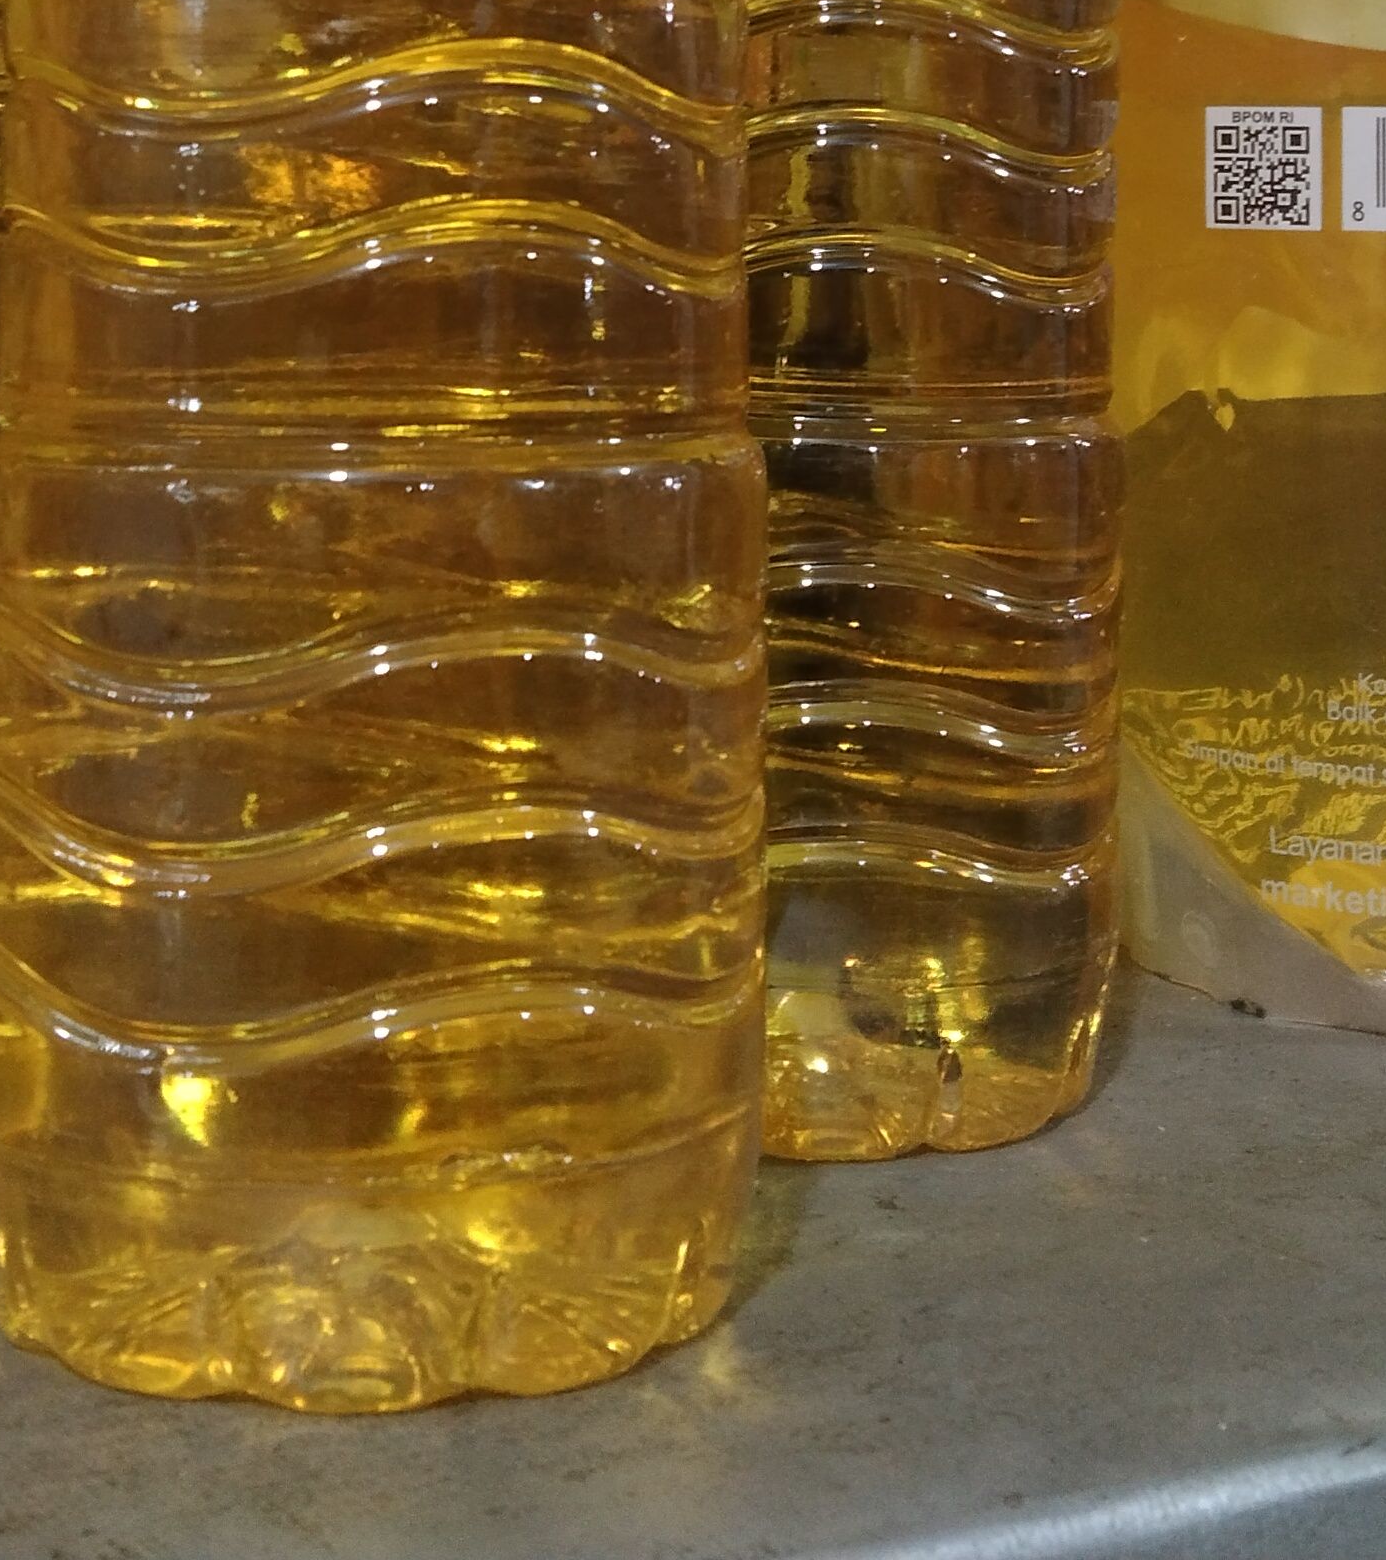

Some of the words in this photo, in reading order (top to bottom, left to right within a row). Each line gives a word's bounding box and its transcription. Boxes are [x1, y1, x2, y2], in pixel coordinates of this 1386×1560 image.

[1232, 111, 1275, 123] BPOM
[1279, 111, 1295, 124] RI
[1351, 201, 1366, 223] 8
[1326, 698, 1377, 722] Baik
[1265, 753, 1286, 773] di
[1291, 755, 1377, 787] tempat
